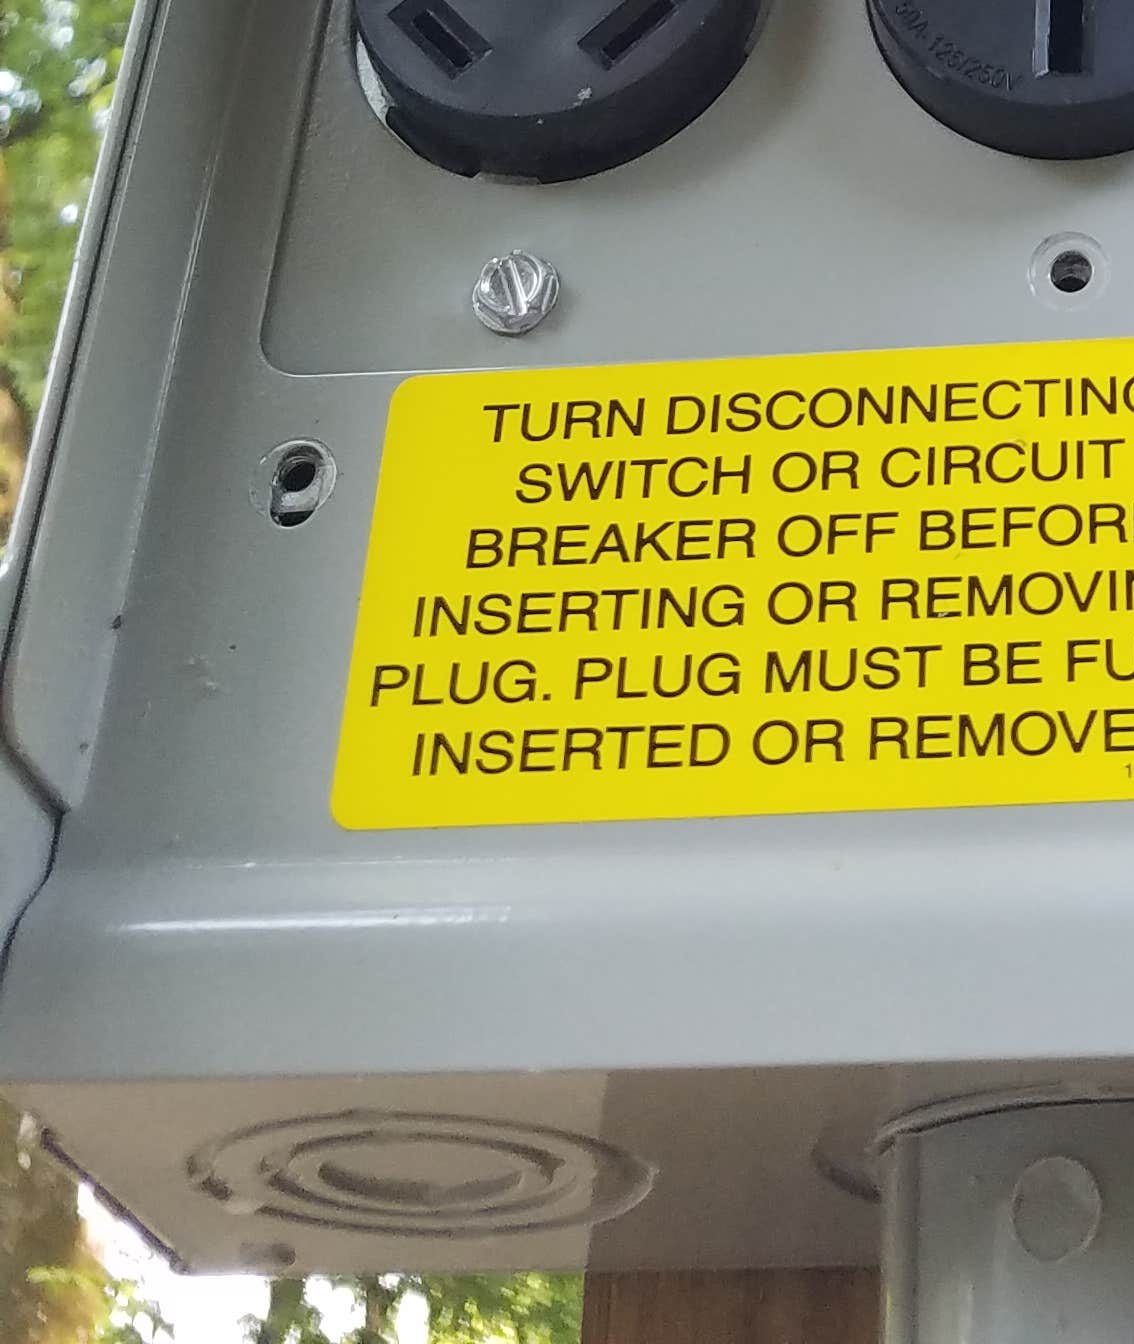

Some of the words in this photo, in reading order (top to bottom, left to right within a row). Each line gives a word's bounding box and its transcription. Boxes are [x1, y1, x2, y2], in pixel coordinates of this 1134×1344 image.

[483, 398, 645, 442] TURN
[516, 455, 751, 503] SWITCH
[773, 451, 859, 492] OR
[881, 439, 1125, 488] CIRCUIT
[467, 519, 755, 568] BREAKER
[778, 512, 898, 557] OFF
[414, 585, 744, 637] INSERTING
[768, 581, 856, 625] OR
[371, 660, 550, 706] PLUG.
[575, 653, 739, 699] PLUG
[765, 645, 942, 693] MUST
[964, 642, 1042, 686] BE
[413, 724, 730, 775] INSERTED
[753, 719, 843, 765] OR
